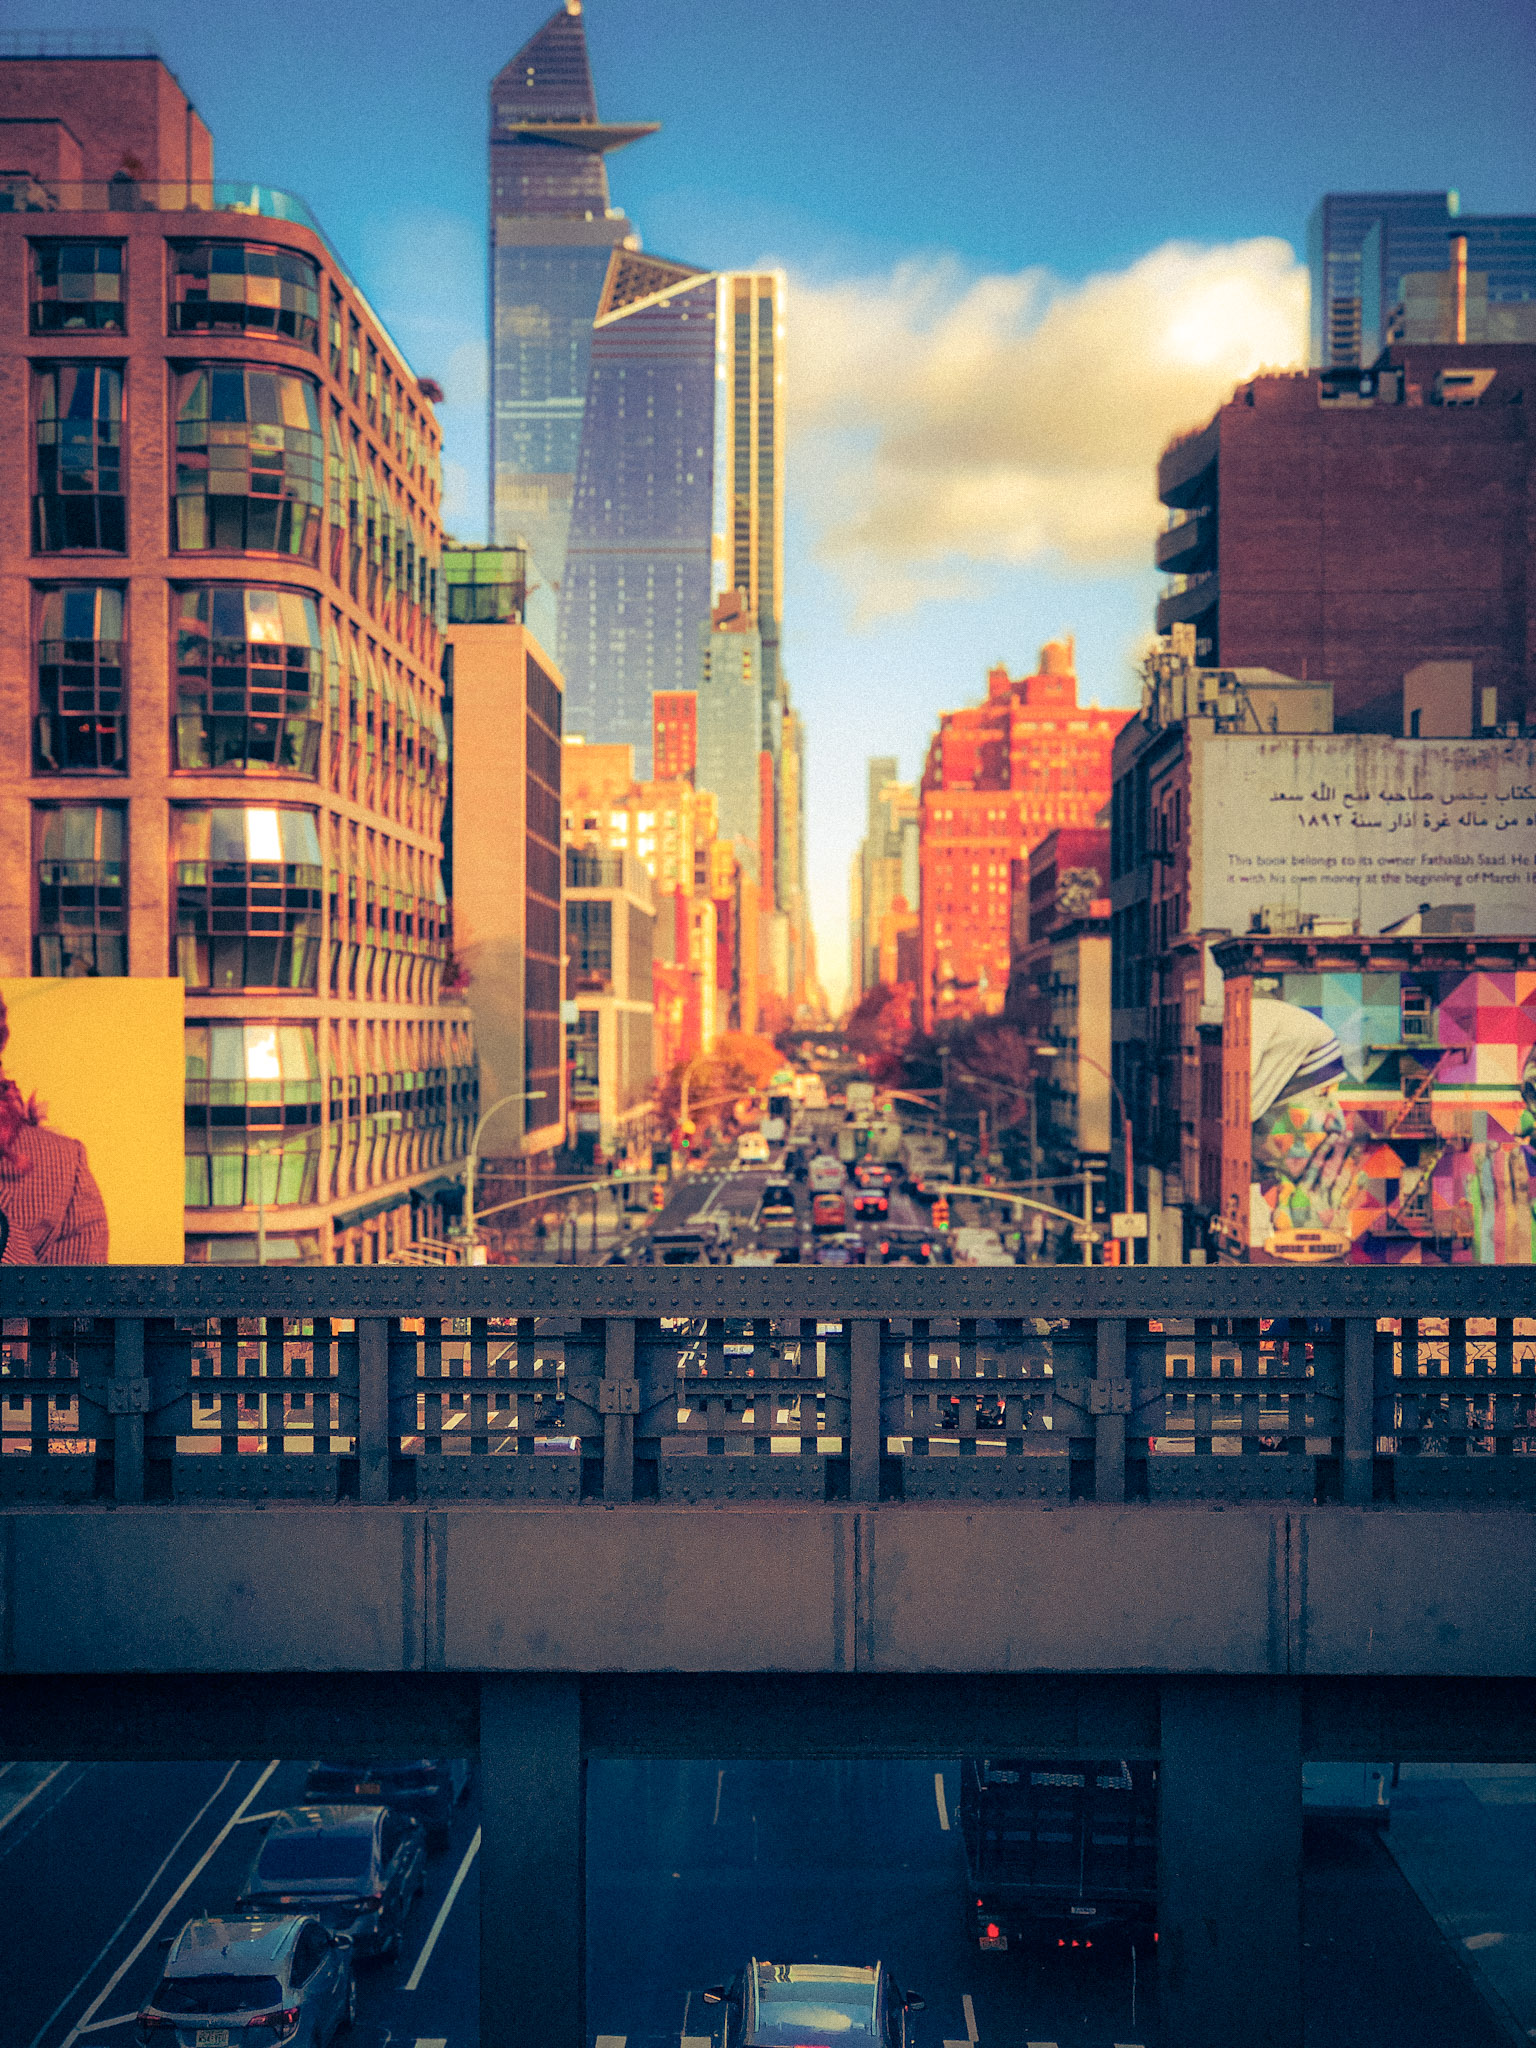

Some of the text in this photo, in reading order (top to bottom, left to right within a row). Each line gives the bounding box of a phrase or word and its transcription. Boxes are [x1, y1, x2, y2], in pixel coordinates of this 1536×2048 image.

[1311, 781, 1336, 802] الله
[1378, 786, 1435, 807] صاحبه
[1350, 811, 1382, 828] سنة
[1423, 812, 1451, 833] غرة
[1458, 811, 1488, 827] ماله
[1495, 813, 1519, 831] من
[1227, 853, 1253, 867] This
[1256, 854, 1286, 867] book
[1291, 854, 1338, 869] belongs
[1341, 855, 1356, 867] to
[1358, 855, 1373, 867] its
[1377, 856, 1416, 867] owner
[1511, 852, 1530, 867] He
[1290, 874, 1317, 884] own
[1319, 874, 1361, 887] money
[1365, 873, 1377, 884] at
[1380, 872, 1402, 884] the
[1404, 871, 1463, 887] beginning
[1465, 871, 1480, 884] of
[1481, 871, 1522, 884] March
